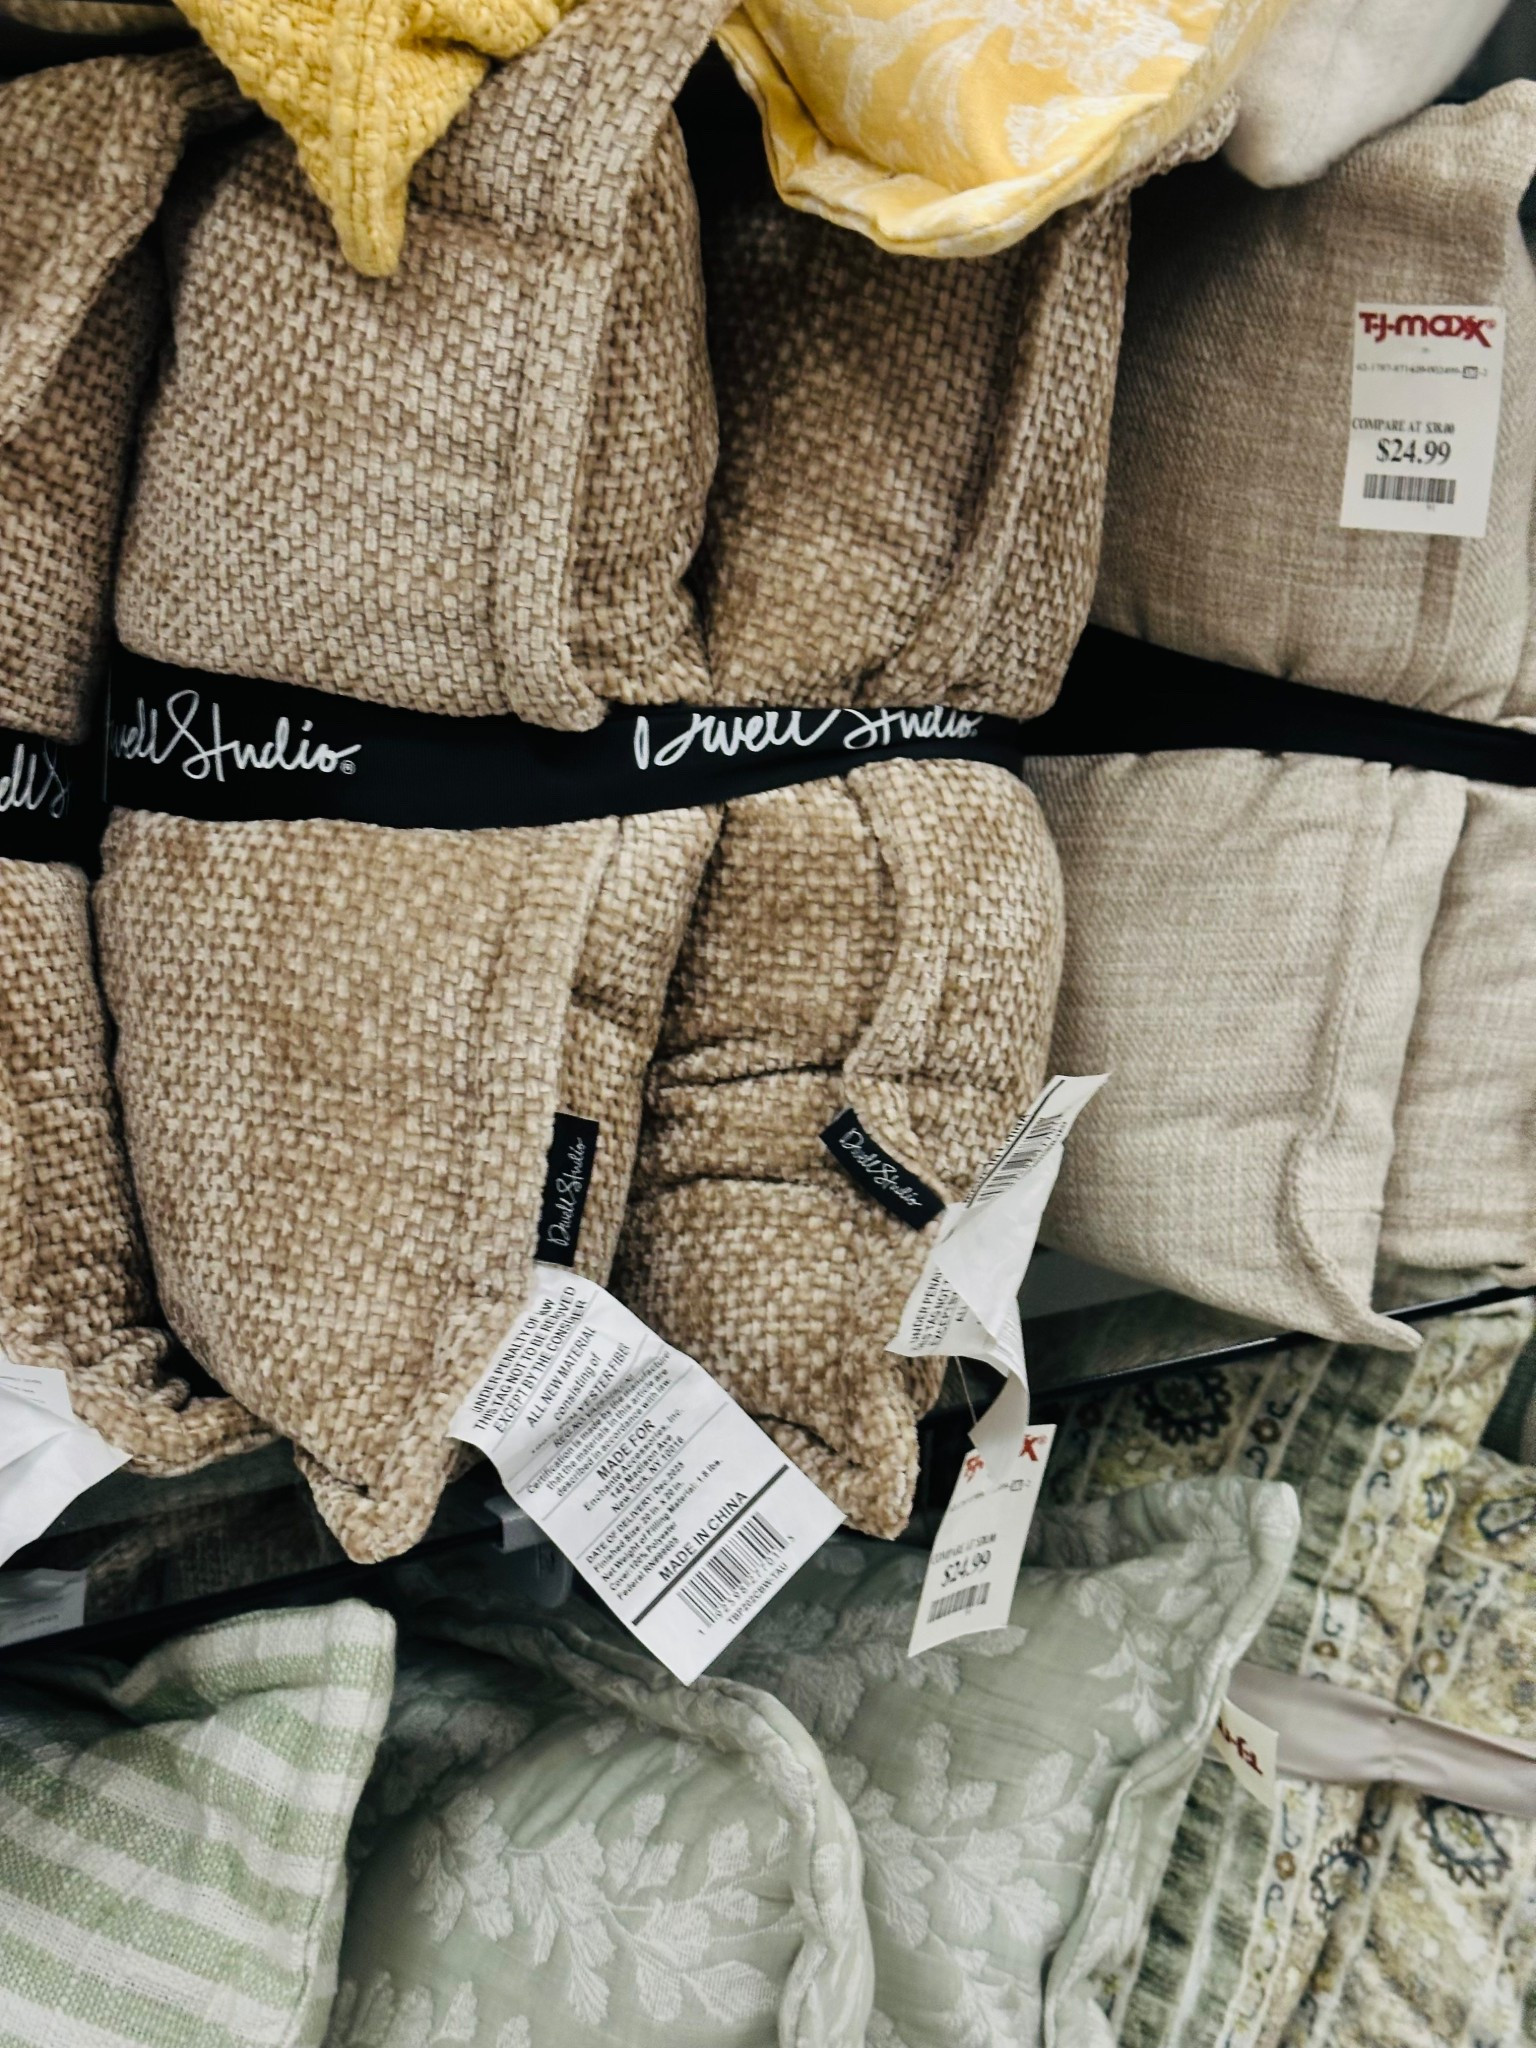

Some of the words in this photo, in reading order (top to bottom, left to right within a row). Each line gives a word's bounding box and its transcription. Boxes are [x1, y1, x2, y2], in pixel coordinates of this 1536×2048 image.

[1352, 417, 1405, 432] COMPARE
[1376, 437, 1452, 466] $24.99
[471, 1374, 501, 1413] UNDER
[493, 1330, 530, 1375] PENALTY
[525, 1316, 540, 1330] OF
[472, 1405, 498, 1431] THIS
[490, 1383, 512, 1408] TAG
[506, 1362, 527, 1383] NOT
[521, 1346, 537, 1360] TO
[530, 1332, 546, 1348] BE
[492, 1390, 529, 1433] EXCEPT
[523, 1374, 537, 1388] BY
[533, 1353, 552, 1372] THE
[525, 1404, 547, 1428] ALL
[539, 1374, 563, 1403] NEW
[556, 1325, 597, 1376] MATERIAL
[552, 1365, 596, 1421] consisting
[589, 1352, 601, 1367] of
[526, 1445, 576, 1495] Certification
[571, 1438, 583, 1449] is
[578, 1417, 604, 1441] made
[598, 1407, 613, 1421] by
[608, 1393, 625, 1409] the
[546, 1472, 565, 1491] that
[562, 1459, 578, 1475] the
[574, 1425, 611, 1463] materials
[607, 1417, 619, 1428] in
[614, 1402, 633, 1420] this
[629, 1379, 656, 1406] article
[653, 1367, 669, 1383] are
[555, 1457, 595, 1498] described
[592, 1449, 603, 1460] in
[599, 1406, 644, 1453] accordance
[640, 1390, 658, 1409] with
[595, 1442, 633, 1481] MADE
[627, 1418, 656, 1447] FOR
[624, 1448, 659, 1485] Madison
[655, 1433, 673, 1452] Ave
[611, 1493, 632, 1513] New
[628, 1472, 652, 1496] York,
[648, 1459, 663, 1474] NY
[660, 1436, 685, 1462] 10016
[586, 1542, 608, 1564] DATE
[605, 1531, 619, 1544] OF
[593, 1539, 627, 1574] Finished
[641, 1512, 653, 1524] 20
[663, 1488, 676, 1501] 20
[601, 1567, 618, 1583] Net
[614, 1542, 642, 1571] Weight
[638, 1533, 650, 1545] of
[646, 1512, 671, 1537] Filling
[646, 1521, 679, 1554] Polyester
[658, 1542, 697, 1582] MADE
[692, 1527, 711, 1546] IN
[705, 1488, 748, 1533] CHINA
[617, 1571, 646, 1602] Federal
